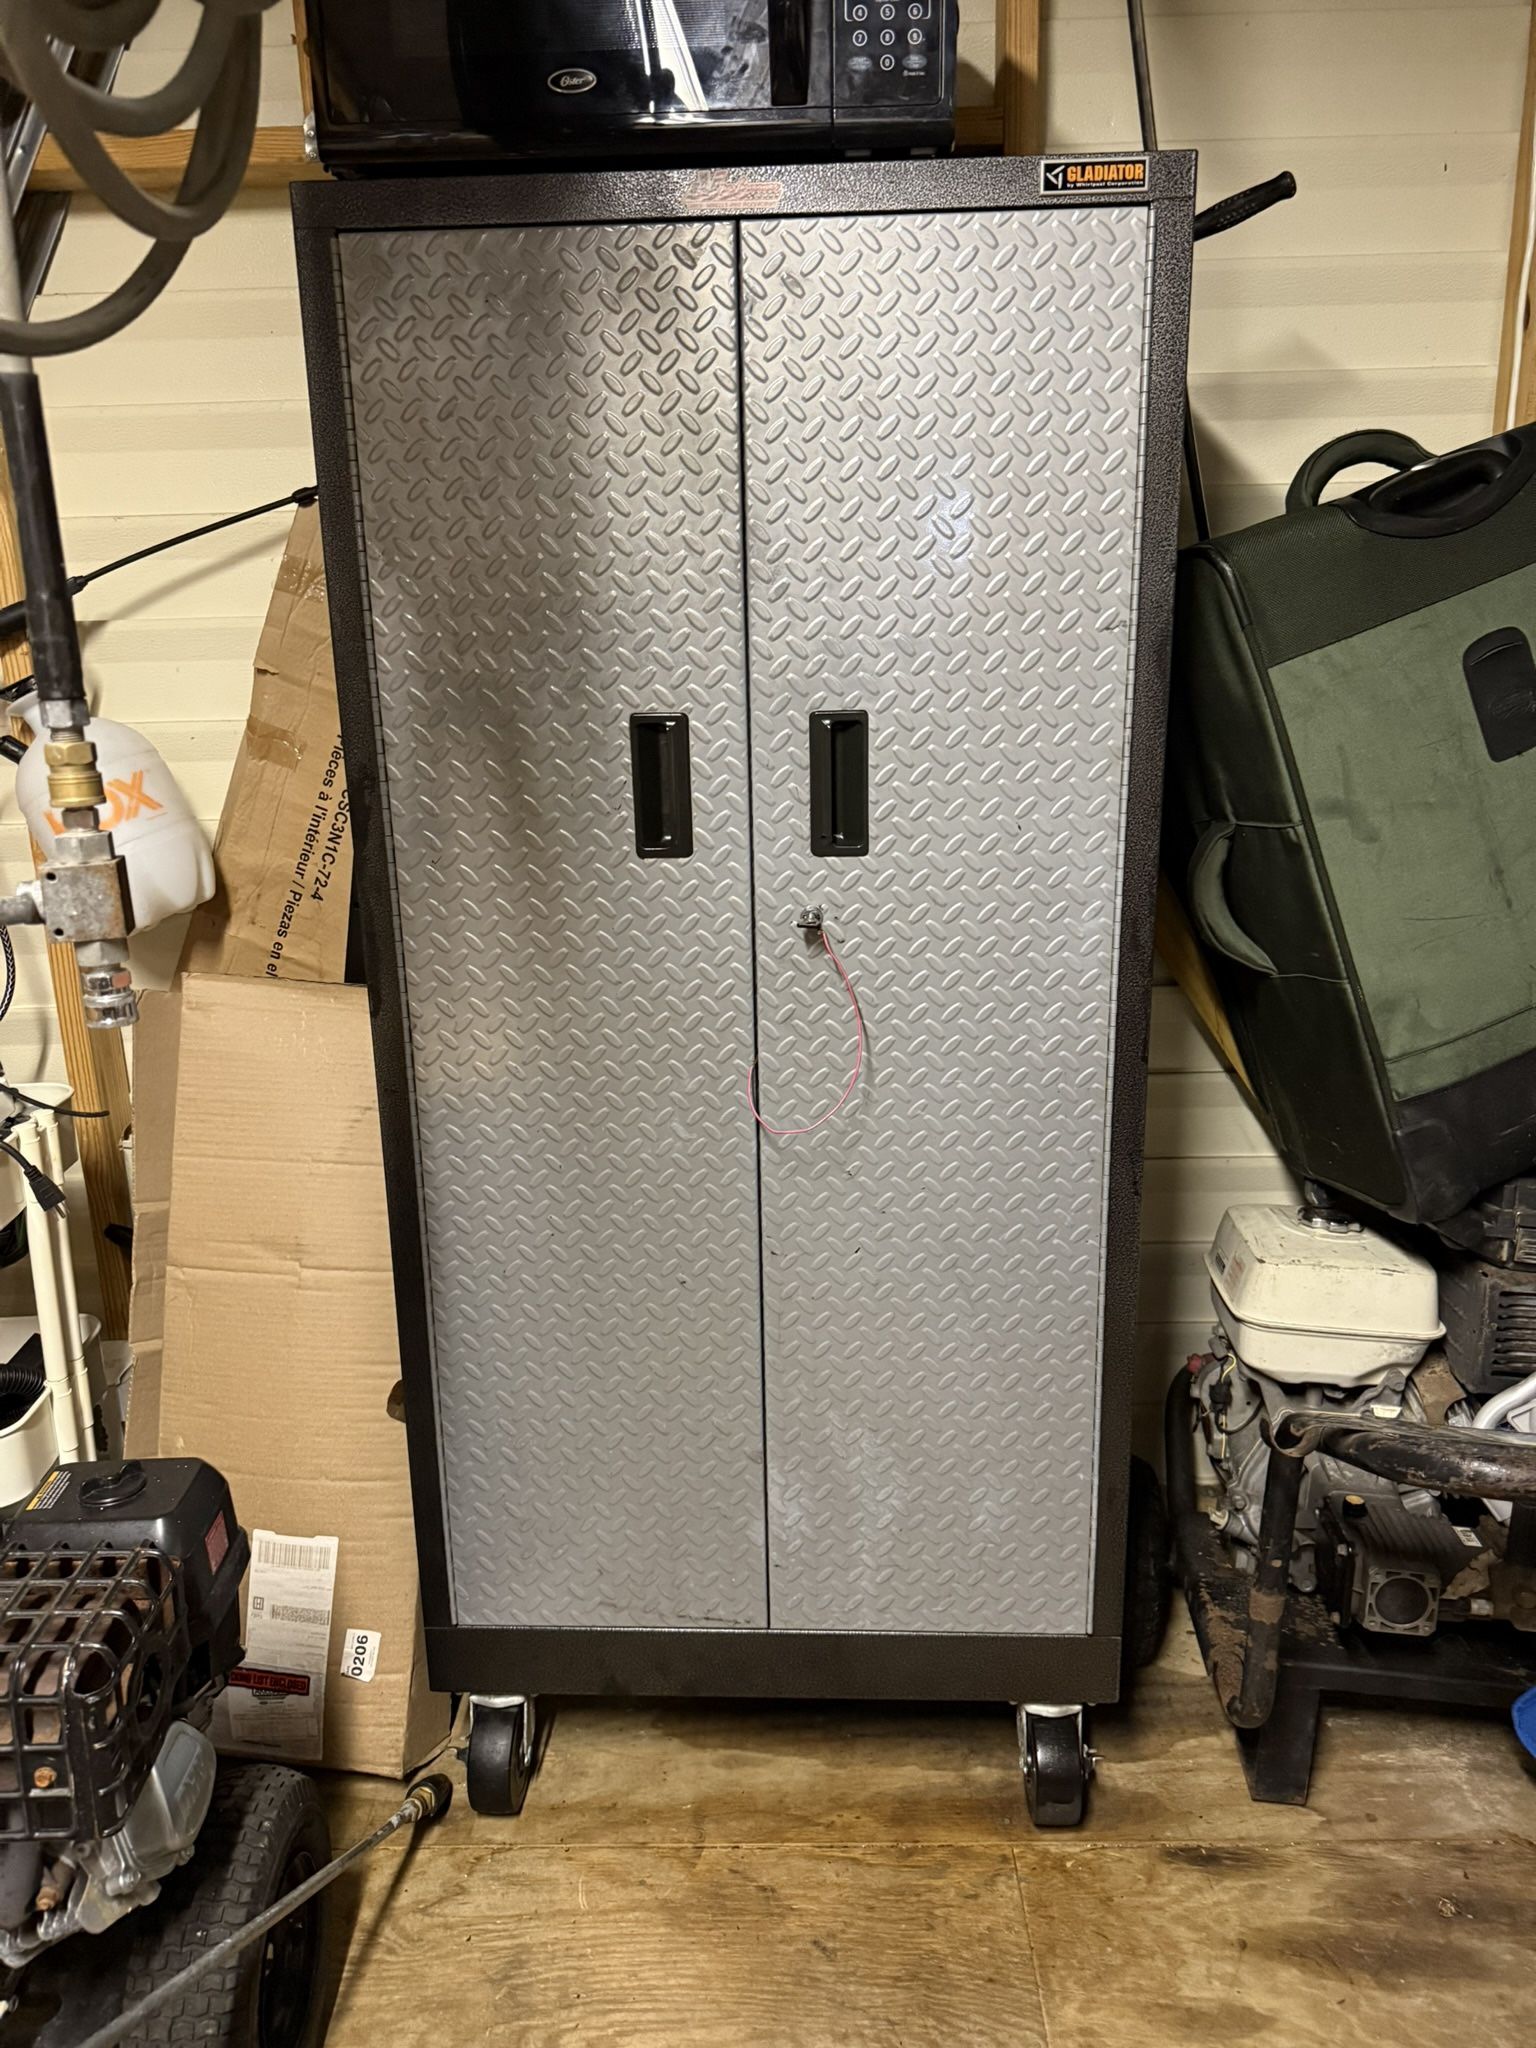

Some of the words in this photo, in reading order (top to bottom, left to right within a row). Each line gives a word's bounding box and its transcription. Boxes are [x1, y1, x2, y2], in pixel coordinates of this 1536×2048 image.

[560, 75, 584, 87] Oster
[1067, 163, 1144, 183] GLADIATOR
[317, 791, 333, 802] à
[294, 804, 328, 880] l'intérieur
[292, 879, 305, 889] /
[276, 889, 303, 938] Piezas
[270, 941, 284, 960] en
[350, 1635, 368, 1677] 0206
